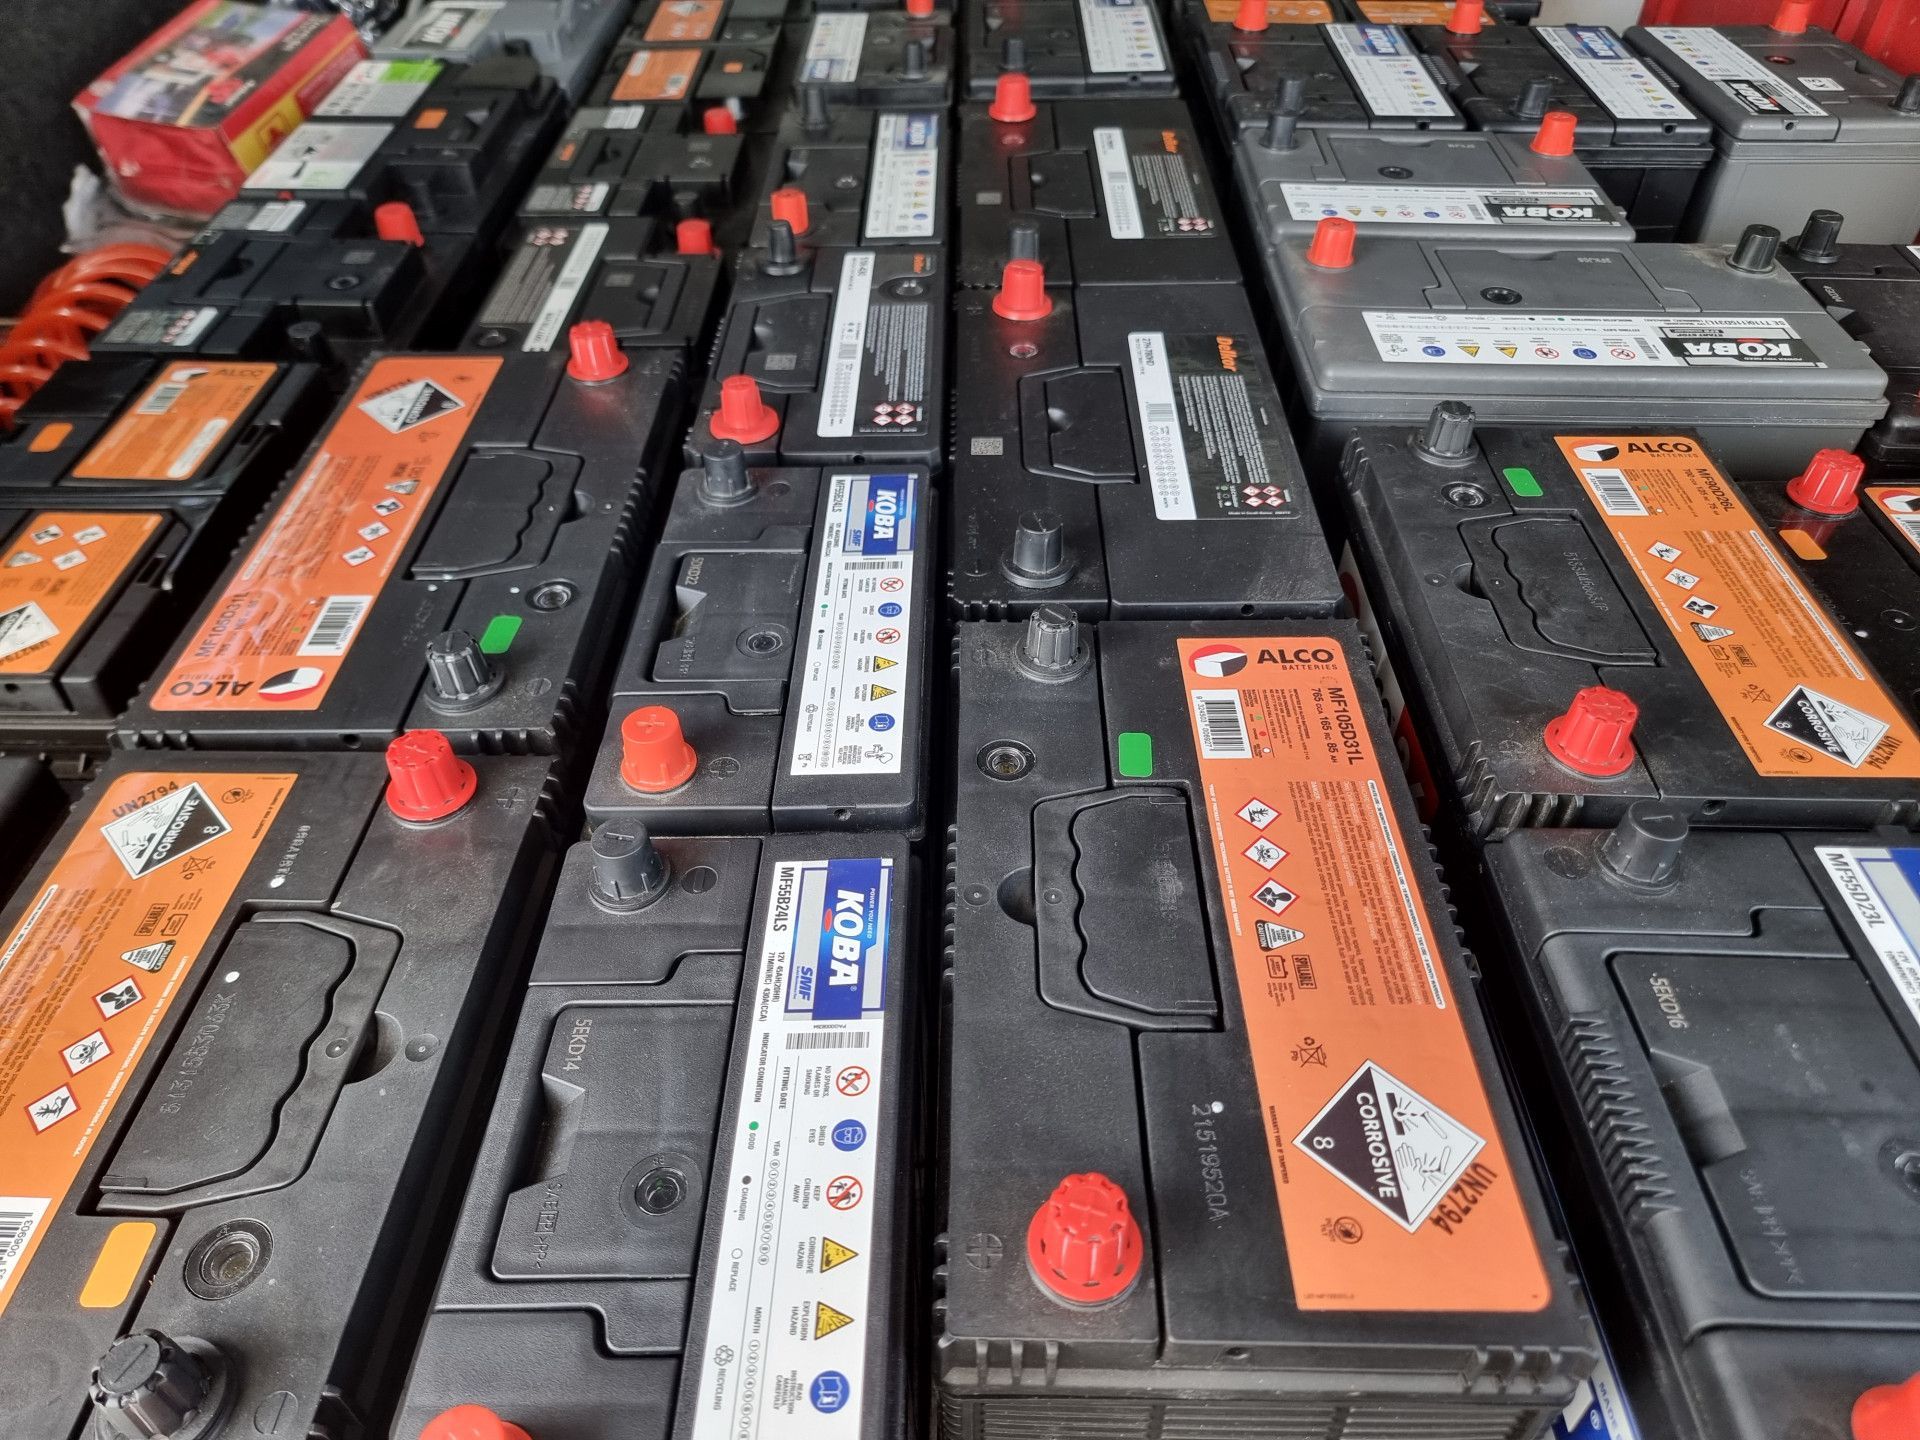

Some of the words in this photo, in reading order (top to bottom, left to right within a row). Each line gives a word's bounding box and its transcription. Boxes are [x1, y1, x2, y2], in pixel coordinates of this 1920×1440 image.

[1364, 28, 1397, 56] KOBA
[1579, 30, 1616, 58] KOBA
[1503, 205, 1593, 218] KOBA
[1216, 336, 1237, 372] Delkor
[1683, 342, 1791, 356] KOBA
[404, 386, 435, 422] CORROSIVE
[1627, 442, 1693, 453] ALCO
[831, 479, 845, 512] MF55B24LS
[1695, 468, 1736, 511] MF90D26L
[872, 490, 897, 539] KOBA
[851, 529, 861, 546] SMF
[193, 591, 249, 656] MF105D31L
[1254, 649, 1335, 663] ALCO
[166, 681, 254, 695] ALCO
[1197, 704, 1207, 722] 324503
[1310, 688, 1323, 701] 765
[1319, 716, 1331, 730] 165
[1326, 743, 1338, 753] 85
[1327, 687, 1365, 765] MF105D31L
[1776, 718, 1789, 730] 8
[1796, 701, 1841, 751] CORROSIVE
[1201, 728, 1212, 747] 006927
[1866, 735, 1903, 771] UN2794
[113, 781, 180, 818] UN2794
[153, 798, 200, 860] CORROSIVE
[204, 825, 220, 834] 8
[773, 867, 794, 932] MF55B24LS
[1826, 852, 1885, 928] MF55D23L
[139, 905, 166, 934] SPILLABLE
[1255, 923, 1267, 946] CAUTION
[829, 890, 864, 985] KOBA
[153, 944, 173, 971] CAUTION
[764, 952, 776, 986] 71MIN(RC)
[1294, 957, 1313, 985] SPILLABLE
[772, 966, 784, 1002] 45AH(20HR)
[798, 966, 814, 1001] SMF
[758, 988, 770, 1022] 430A(CCA)
[1651, 974, 1688, 1029] 5EKD16
[562, 1018, 592, 1071] 5EKD14
[759, 1032, 770, 1065] INDICATOR
[754, 1066, 765, 1102] CONDITION
[780, 1066, 790, 1093] FITTING
[804, 1069, 812, 1095] SMOKING
[813, 1090, 818, 1098] OR
[822, 1074, 830, 1098] SPARKS,
[778, 1094, 788, 1110] DATE
[748, 1133, 756, 1150] GOOD
[808, 1128, 816, 1144] EYES
[818, 1125, 827, 1146] SHIELD
[1313, 1136, 1334, 1151] 8
[1356, 1092, 1399, 1199] CORROSIVE
[738, 1188, 750, 1221] CHARGING
[792, 1184, 800, 1202] AWAY
[802, 1178, 812, 1210] CHILDREN
[1430, 1162, 1497, 1236] UN2794
[8, 1219, 33, 1257] 006903
[796, 1242, 805, 1268] HAZARD
[806, 1236, 816, 1274] CORROSIVE
[728, 1262, 740, 1292] REPLACE
[753, 1306, 762, 1334] MONTH
[790, 1306, 798, 1336] HAZARD
[800, 1301, 810, 1340] EXPLOSION
[713, 1368, 726, 1410] RECYCLING
[774, 1375, 783, 1410] CAREFULLY
[782, 1378, 790, 1406] MANUAL
[787, 1370, 797, 1414] INSTRUCTION
[796, 1383, 804, 1400] READ
